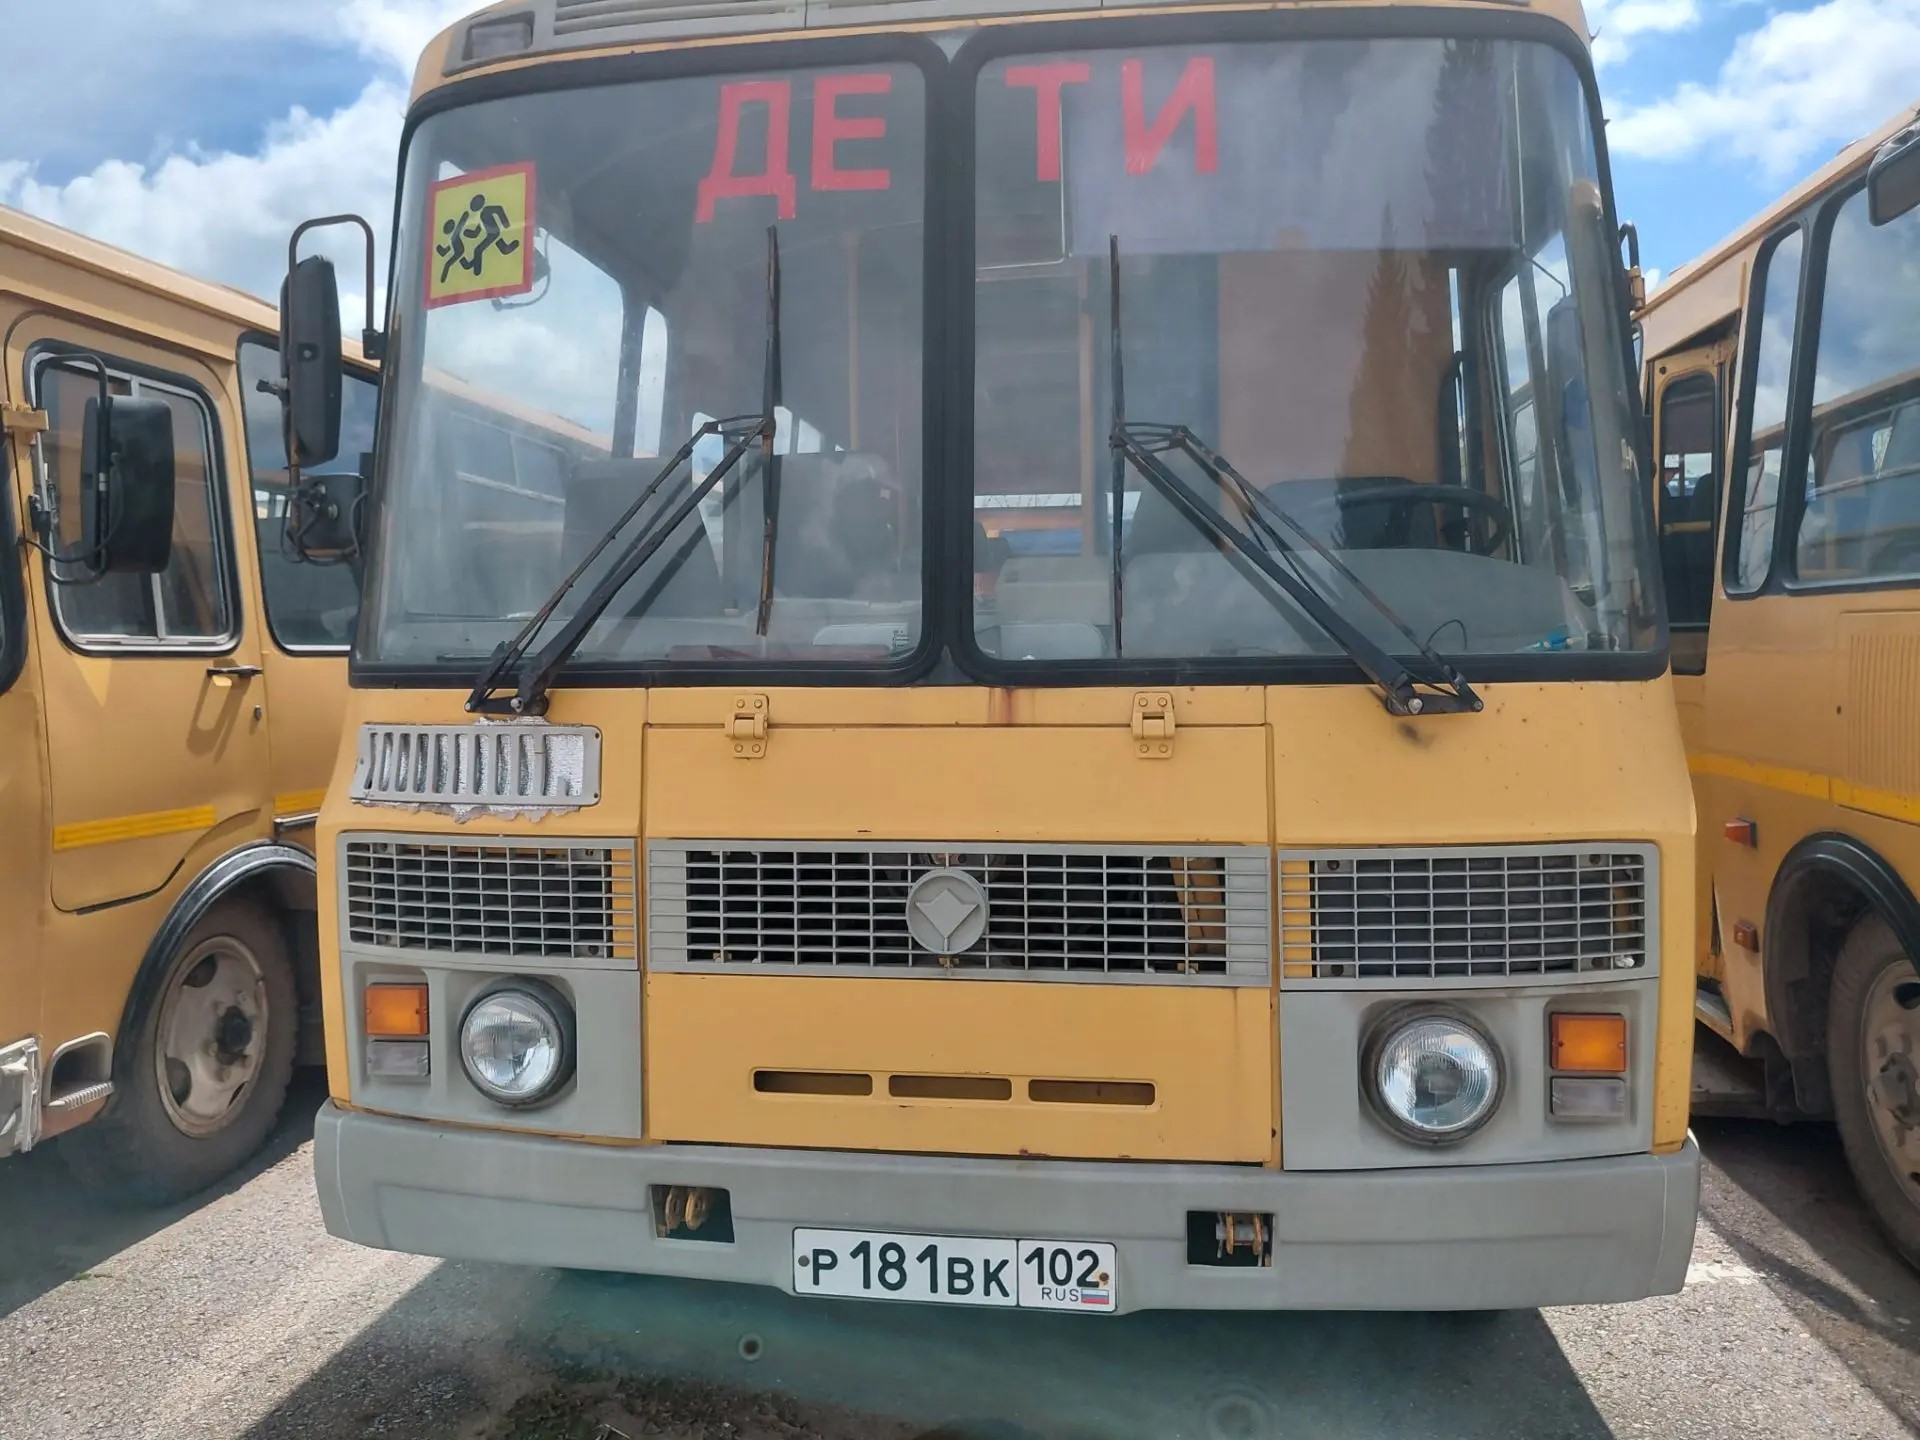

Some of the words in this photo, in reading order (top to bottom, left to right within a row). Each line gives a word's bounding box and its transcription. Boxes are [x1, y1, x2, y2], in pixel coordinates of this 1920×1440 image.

[695, 57, 1218, 223] ДЕТИ
[1024, 1246, 1101, 1289] 102
[1041, 1286, 1079, 1302] RUS
